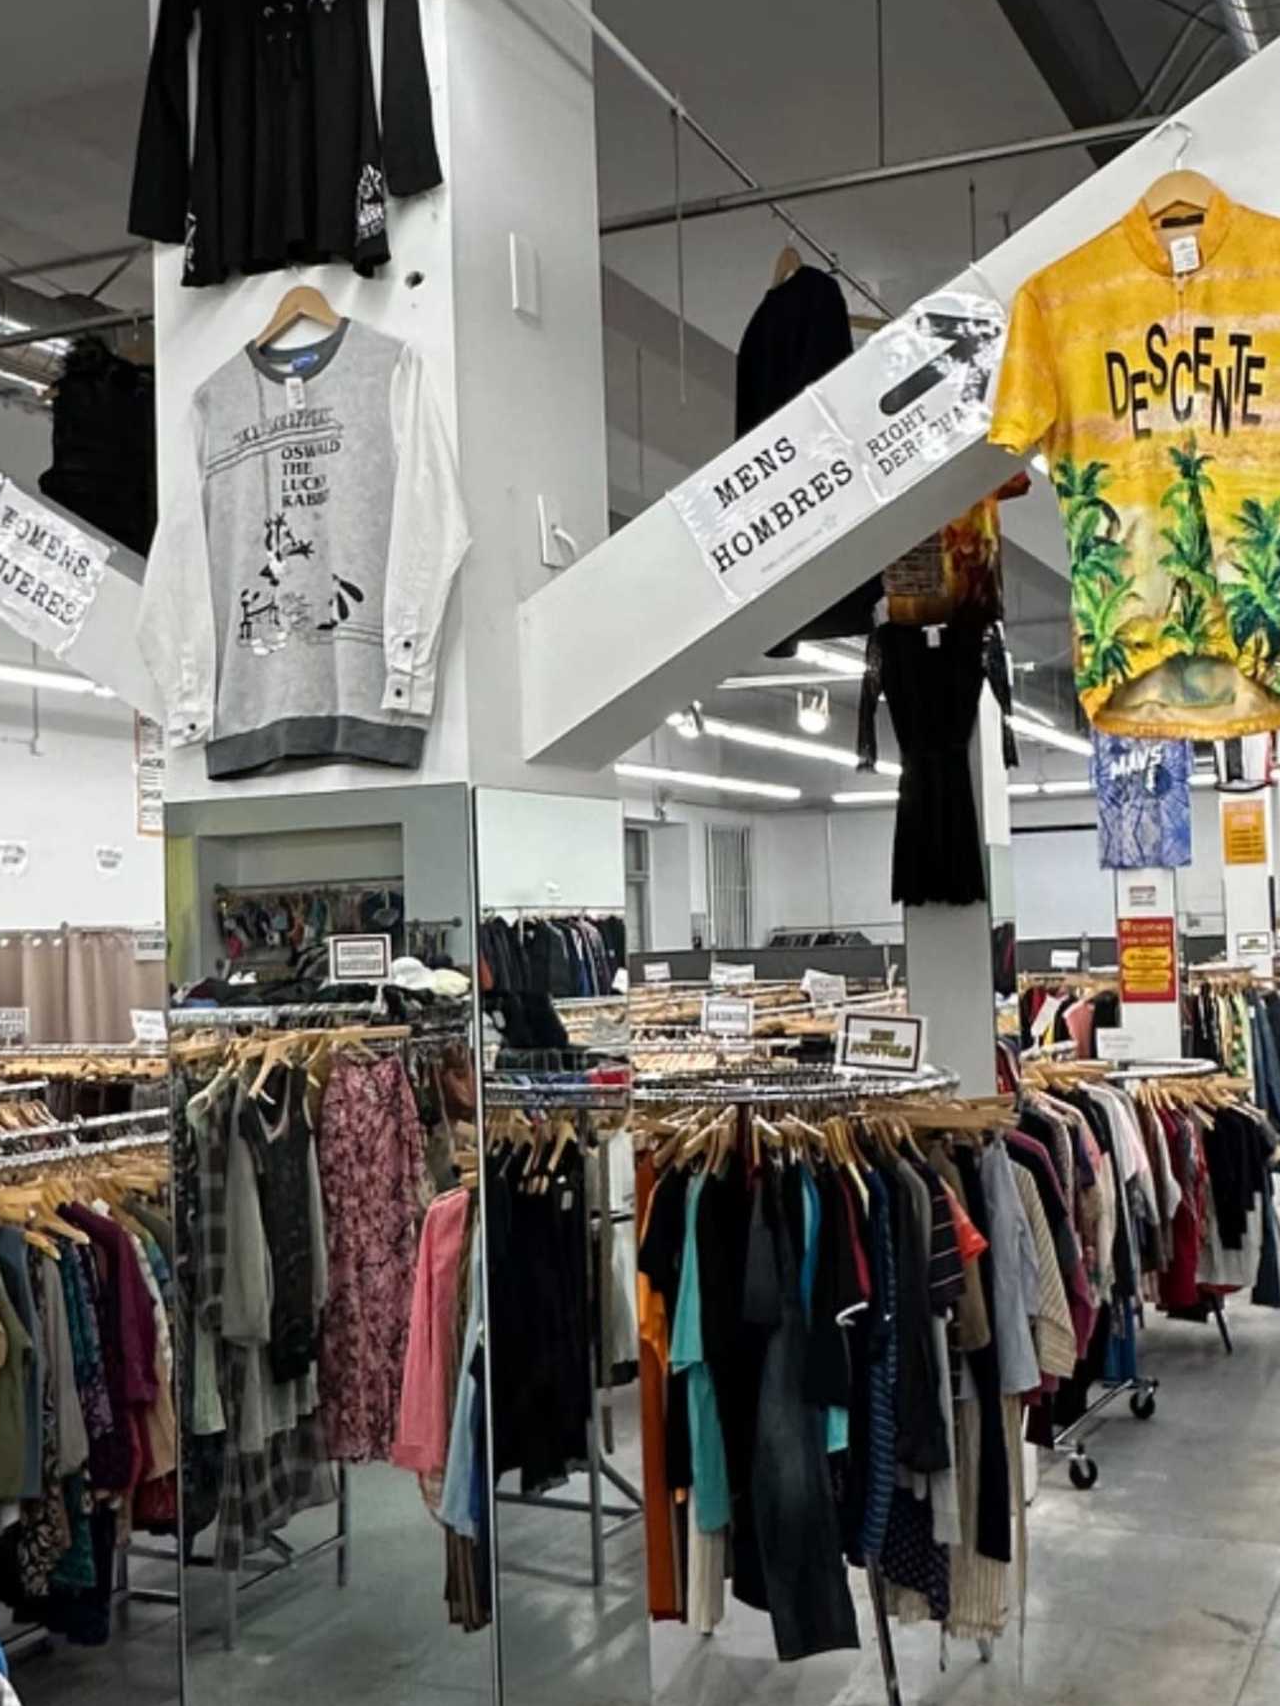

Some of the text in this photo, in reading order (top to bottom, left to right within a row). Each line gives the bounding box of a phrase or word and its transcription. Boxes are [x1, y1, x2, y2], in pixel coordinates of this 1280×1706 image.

[1105, 322, 1266, 441] DESCENTE
[867, 404, 931, 459] RIGHT
[282, 462, 313, 476] THE
[713, 436, 798, 509] MENS
[709, 460, 853, 574] HOMBRES
